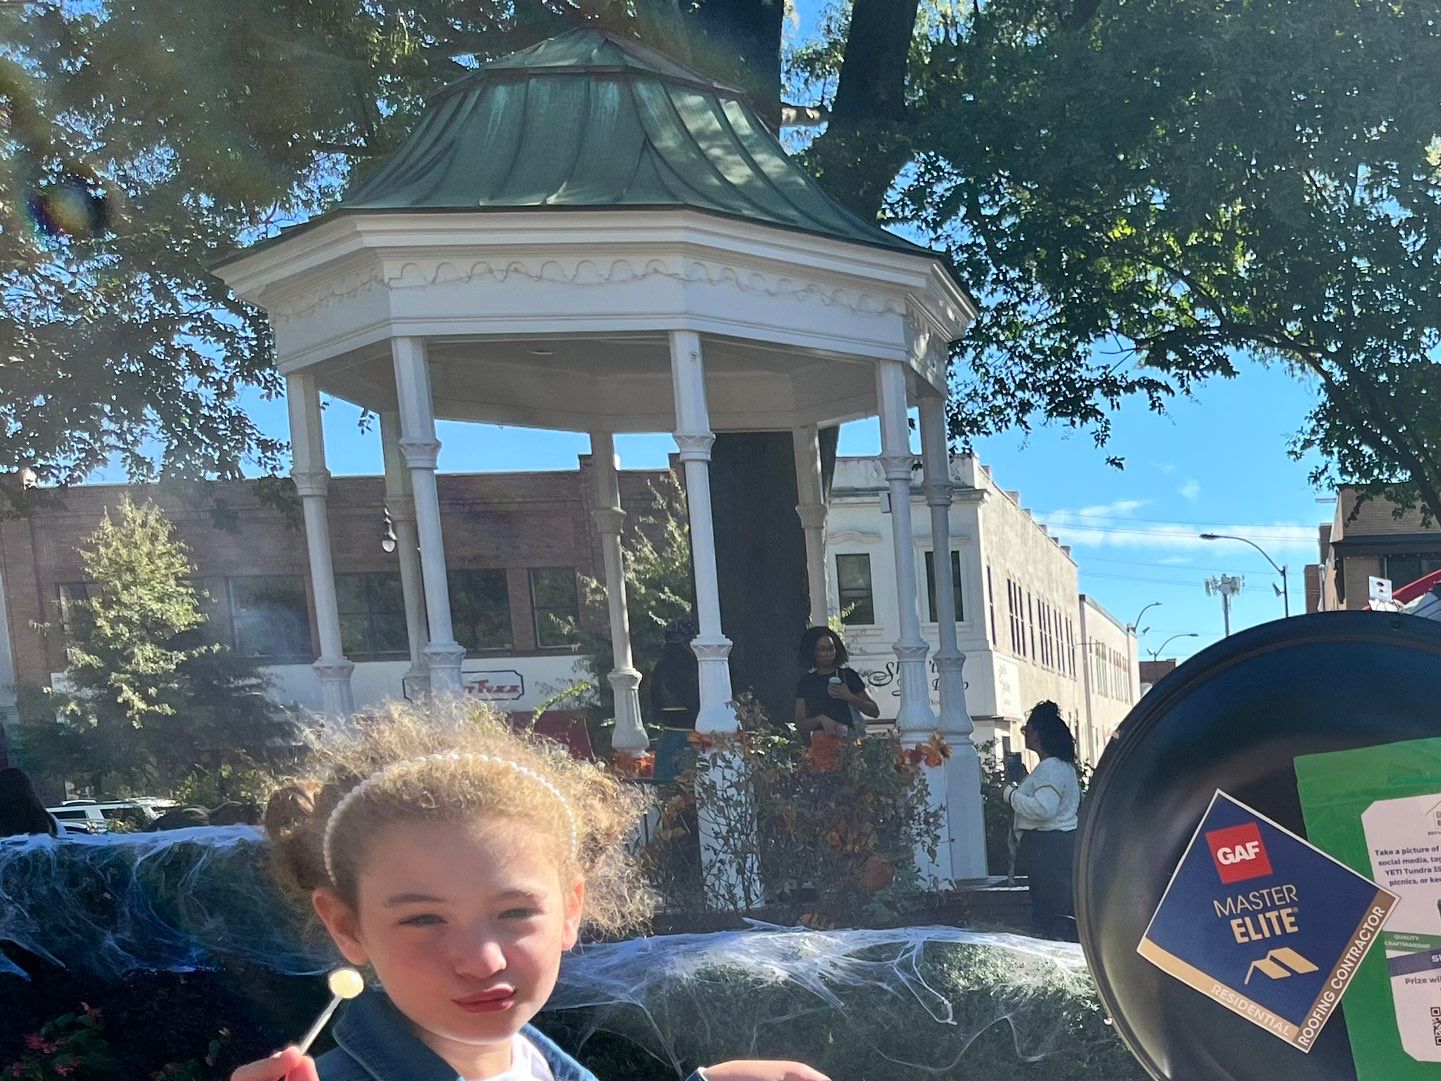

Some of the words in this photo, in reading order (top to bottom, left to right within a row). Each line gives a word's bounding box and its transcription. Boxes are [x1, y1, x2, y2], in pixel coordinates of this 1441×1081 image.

[1216, 840, 1260, 866] GAF
[1401, 847, 1429, 857] picture
[1378, 858, 1401, 866] social
[1384, 868, 1402, 876] YETI
[1404, 866, 1433, 875] Tundra
[1213, 884, 1299, 919] MASTER
[1297, 990, 1336, 1047] ROOFING
[1331, 905, 1386, 991] CONTRACTOR
[1405, 976, 1427, 985] Prize
[1211, 984, 1292, 1037] RESIDENTIAL
